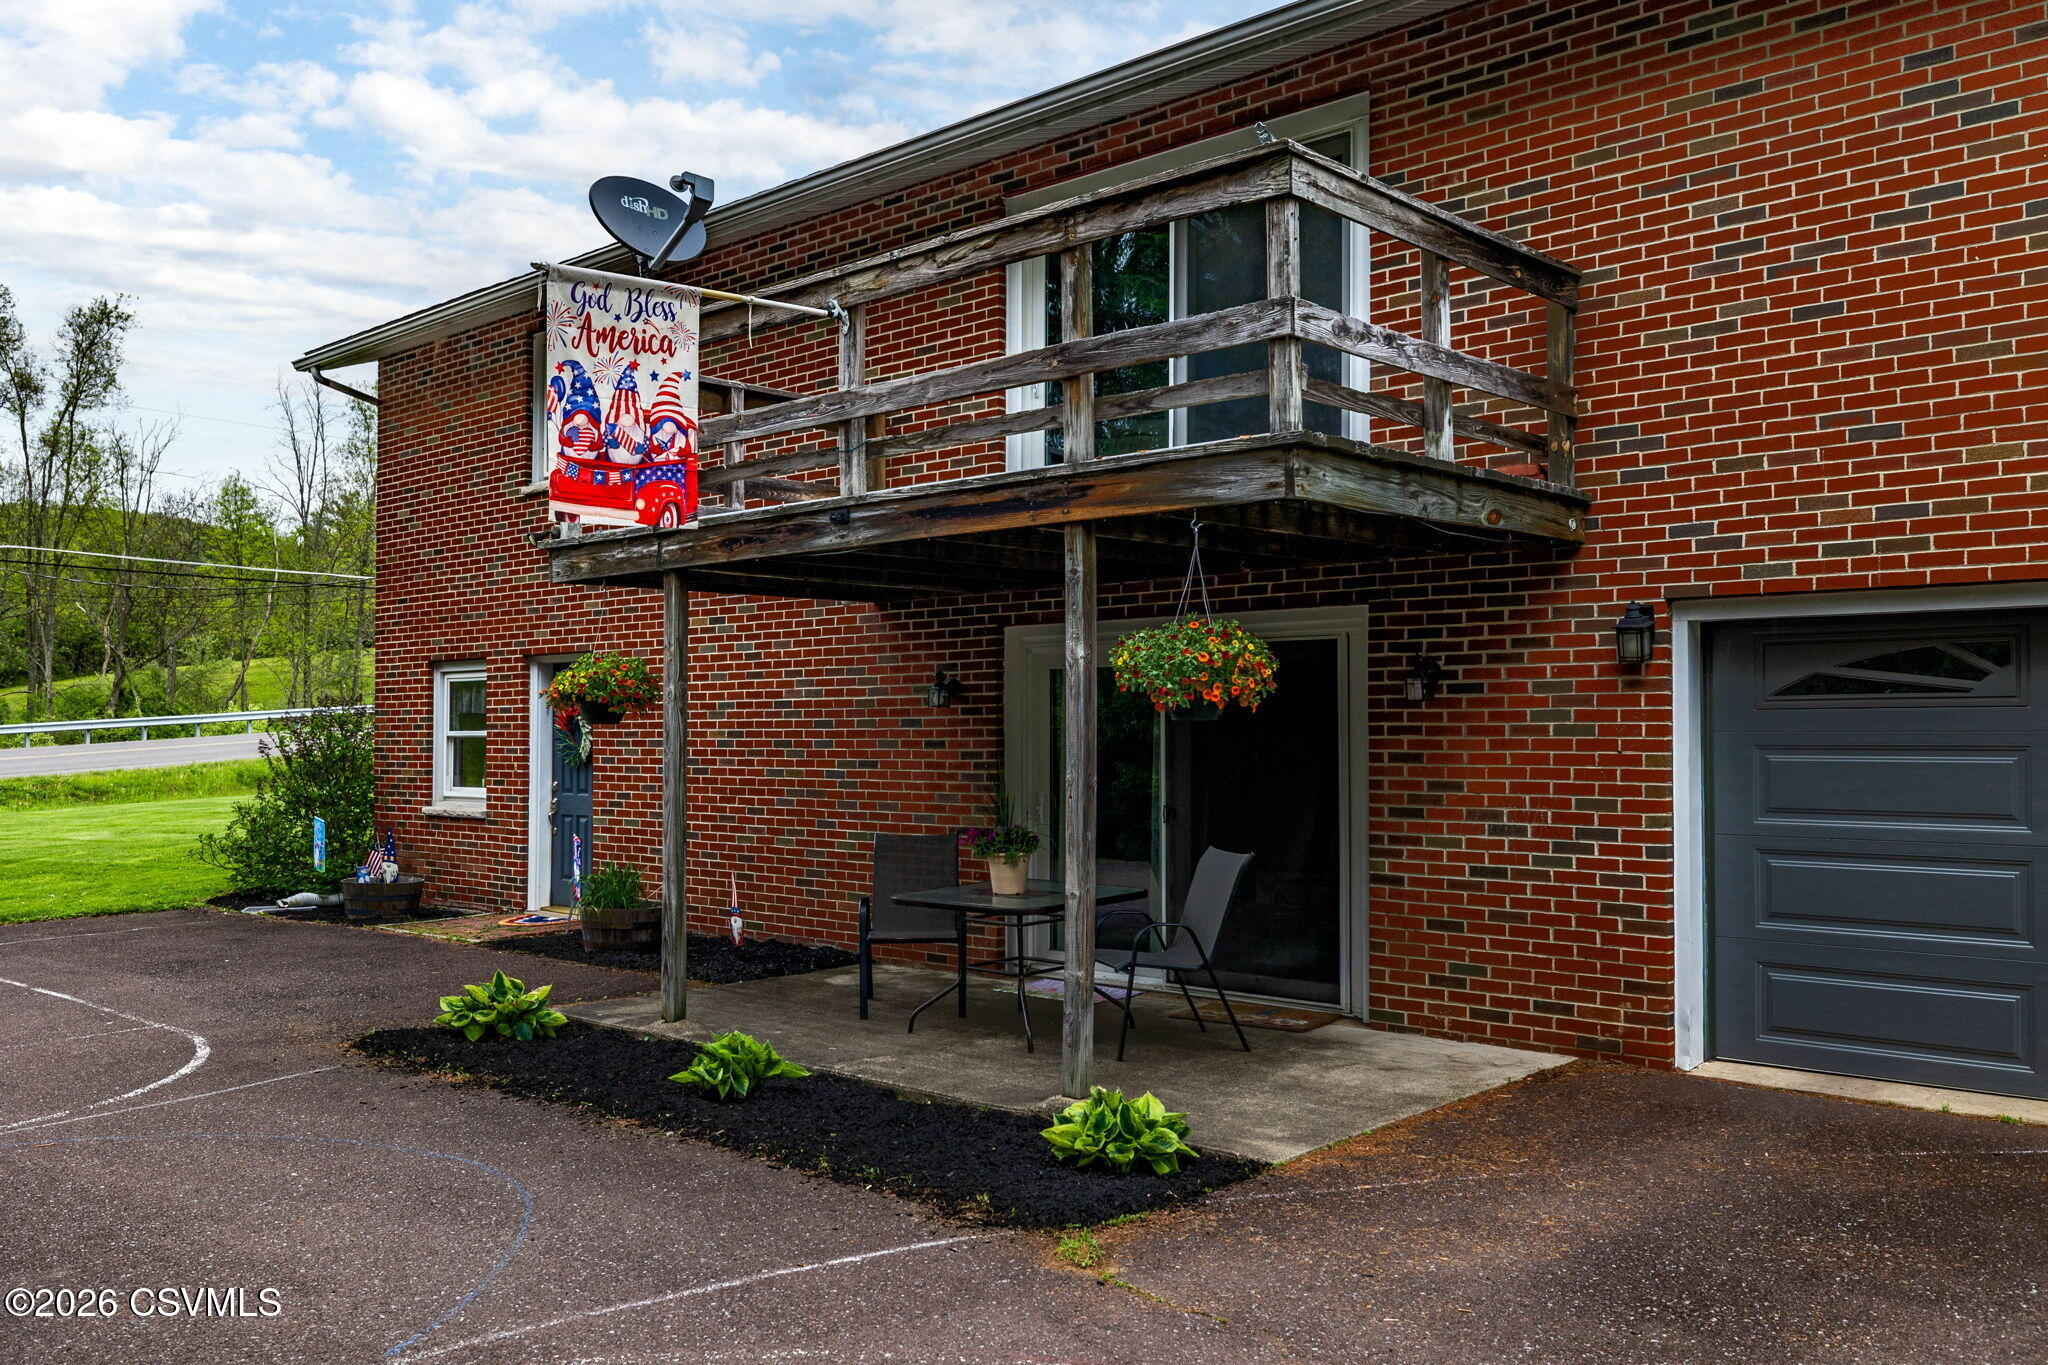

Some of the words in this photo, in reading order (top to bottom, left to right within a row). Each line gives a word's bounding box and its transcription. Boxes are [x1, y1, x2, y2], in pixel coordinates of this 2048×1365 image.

[571, 281, 613, 317] God
[624, 287, 677, 323] Bless
[571, 311, 677, 357] America
